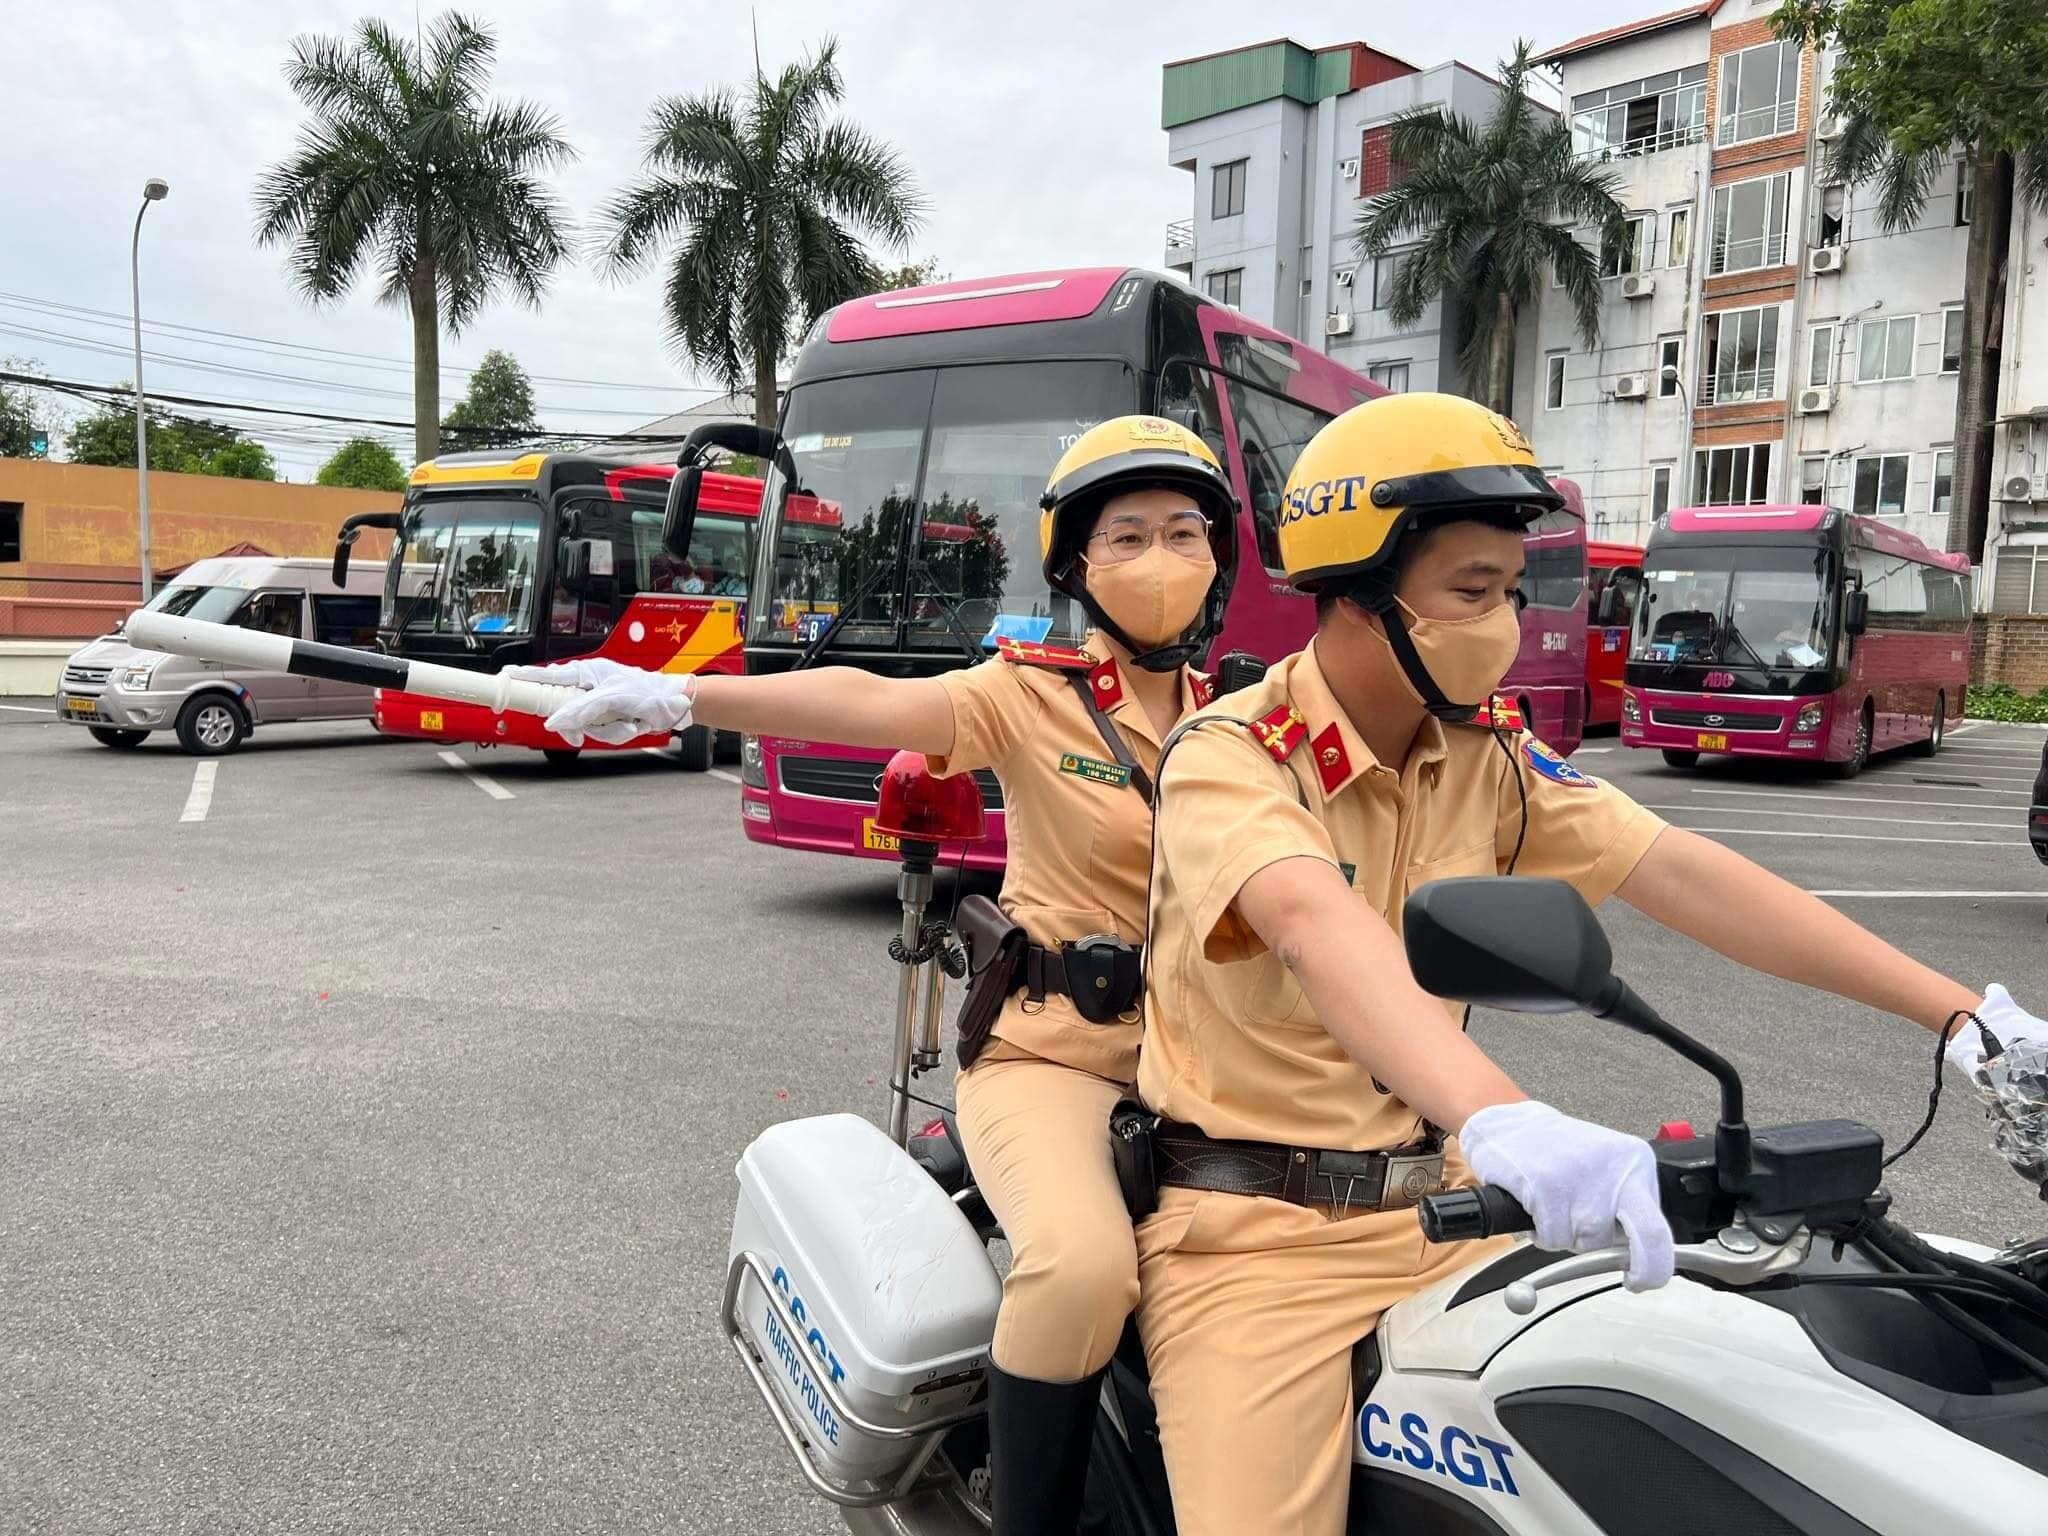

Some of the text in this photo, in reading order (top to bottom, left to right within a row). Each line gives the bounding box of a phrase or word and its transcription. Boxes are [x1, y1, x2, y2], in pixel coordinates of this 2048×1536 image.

[1280, 475, 1365, 528] CSGT
[809, 621, 818, 641] B
[766, 1307, 840, 1446] TRAFFIC POLICE
[1361, 1403, 1521, 1497] C.S.G.T
